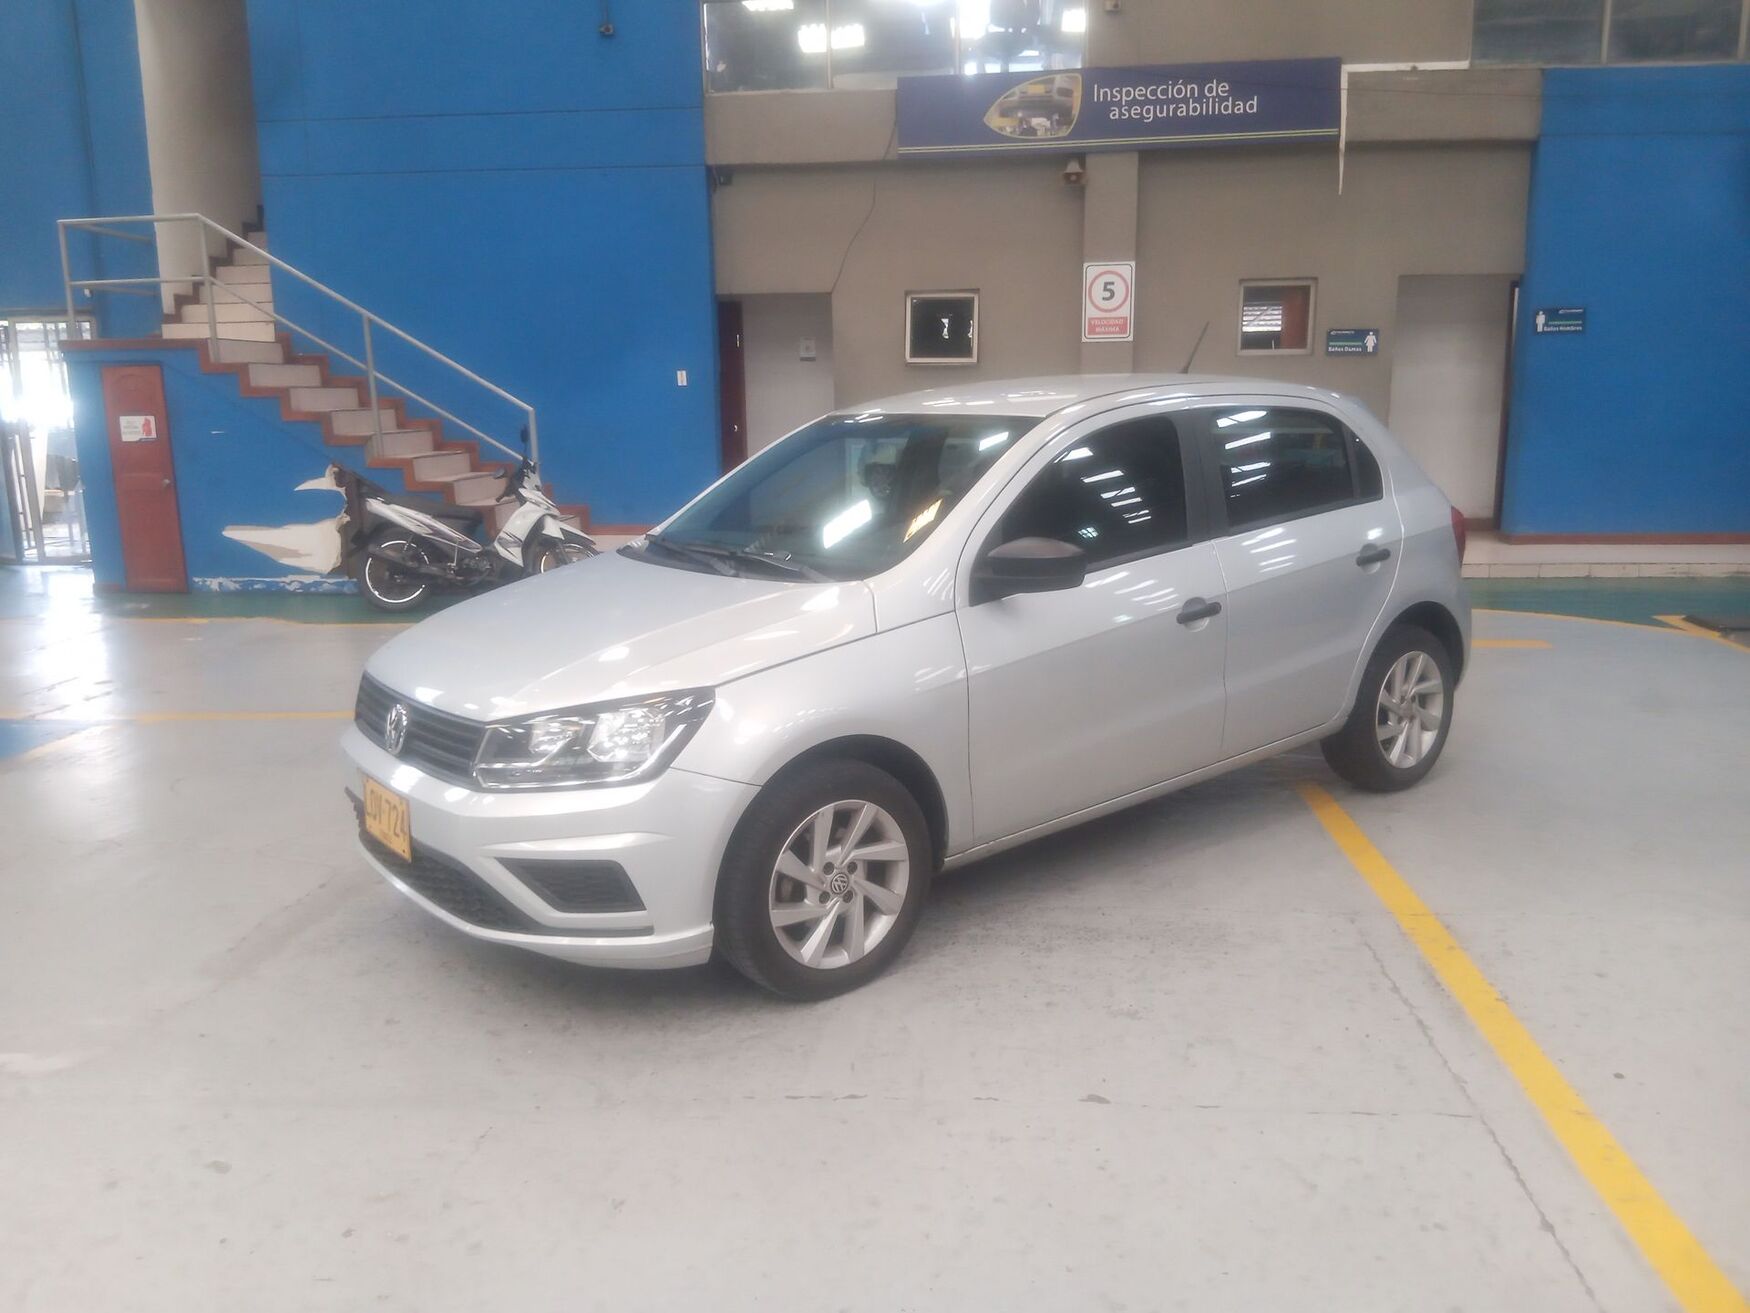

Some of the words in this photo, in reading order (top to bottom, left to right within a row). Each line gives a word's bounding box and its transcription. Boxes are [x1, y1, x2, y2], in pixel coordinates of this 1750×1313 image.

[1093, 79, 1198, 106] Inspección
[1204, 79, 1229, 97] de
[1109, 95, 1258, 123] asegurabilidad
[1102, 281, 1115, 301] 5
